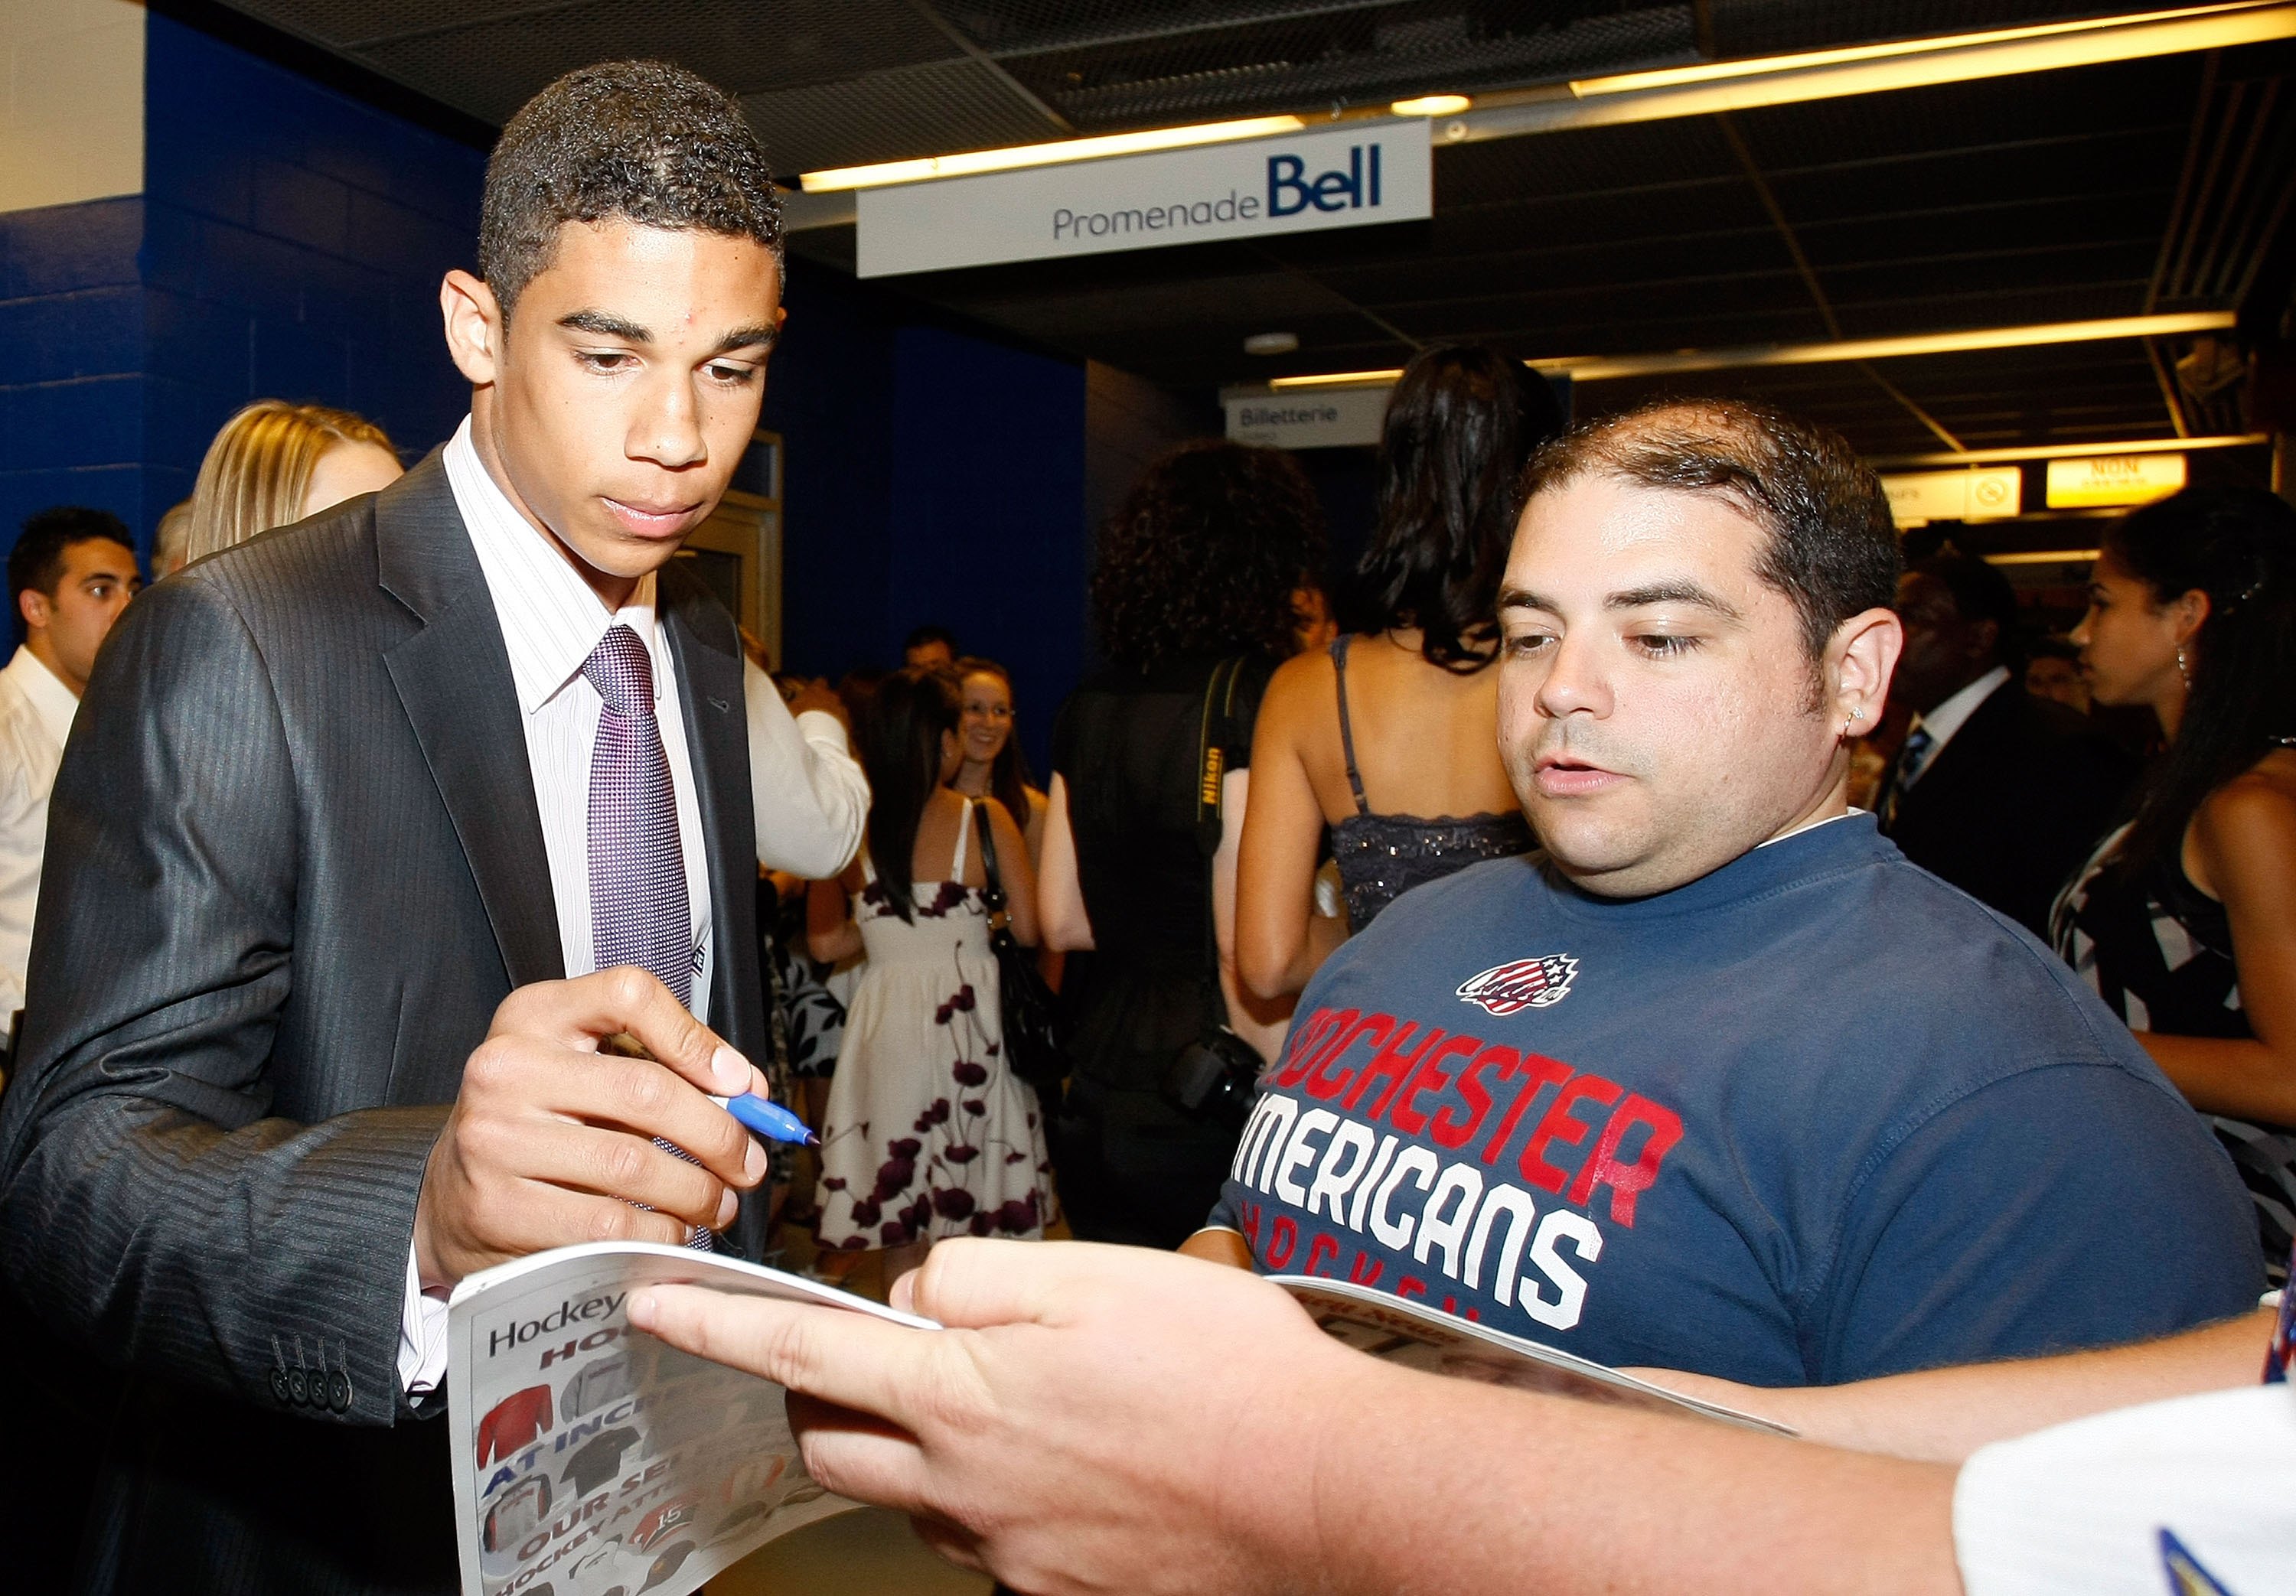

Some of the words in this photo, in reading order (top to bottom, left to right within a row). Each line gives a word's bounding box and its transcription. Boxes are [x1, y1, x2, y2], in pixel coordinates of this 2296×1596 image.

[1054, 191, 1259, 239] Promenade
[1267, 145, 1381, 217] Bell
[1203, 748, 1220, 804] Nikon
[1231, 1092, 1603, 1331] MERICANS
[488, 1290, 626, 1358] Hockey
[481, 1445, 546, 1500] AT
[517, 1492, 609, 1561] OUR
